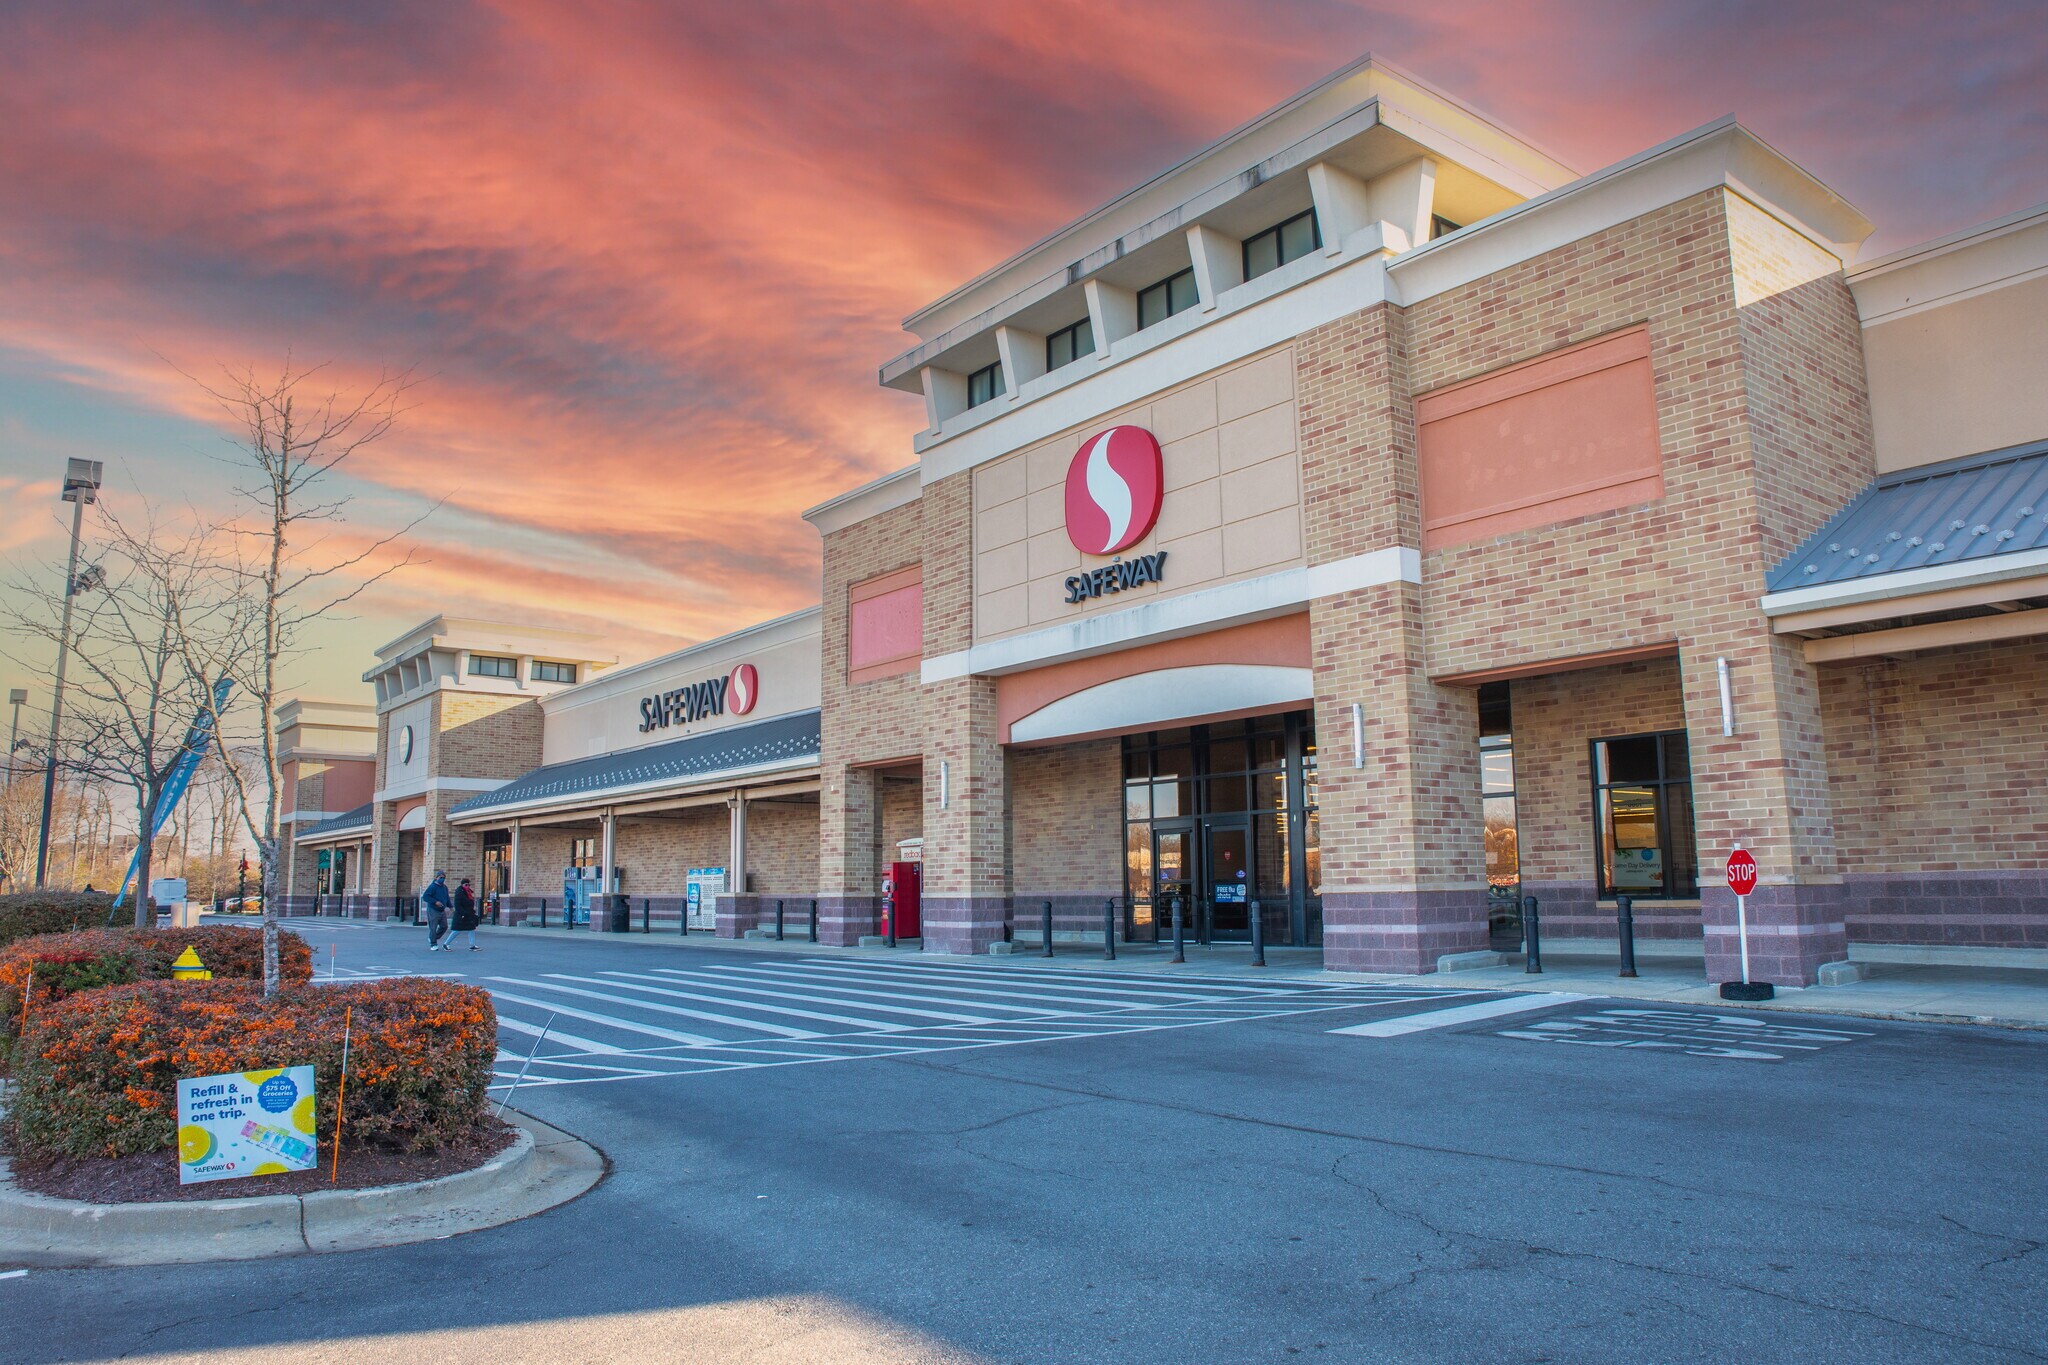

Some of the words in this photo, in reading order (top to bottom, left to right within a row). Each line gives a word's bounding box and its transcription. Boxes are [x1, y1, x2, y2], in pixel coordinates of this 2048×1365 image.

[1065, 551, 1168, 603] SAFEWAY
[639, 675, 729, 732] SAFEWAY
[1627, 862, 1638, 870] Day
[1639, 862, 1661, 870] Delivery
[1728, 863, 1755, 882] STOP
[191, 1085, 224, 1098] Refill
[228, 1083, 238, 1094] &
[191, 1096, 237, 1110] refresh
[241, 1094, 253, 1105] in
[191, 1112, 215, 1122] one
[219, 1108, 246, 1119] trip.
[193, 1164, 225, 1174] SAFEWAY
